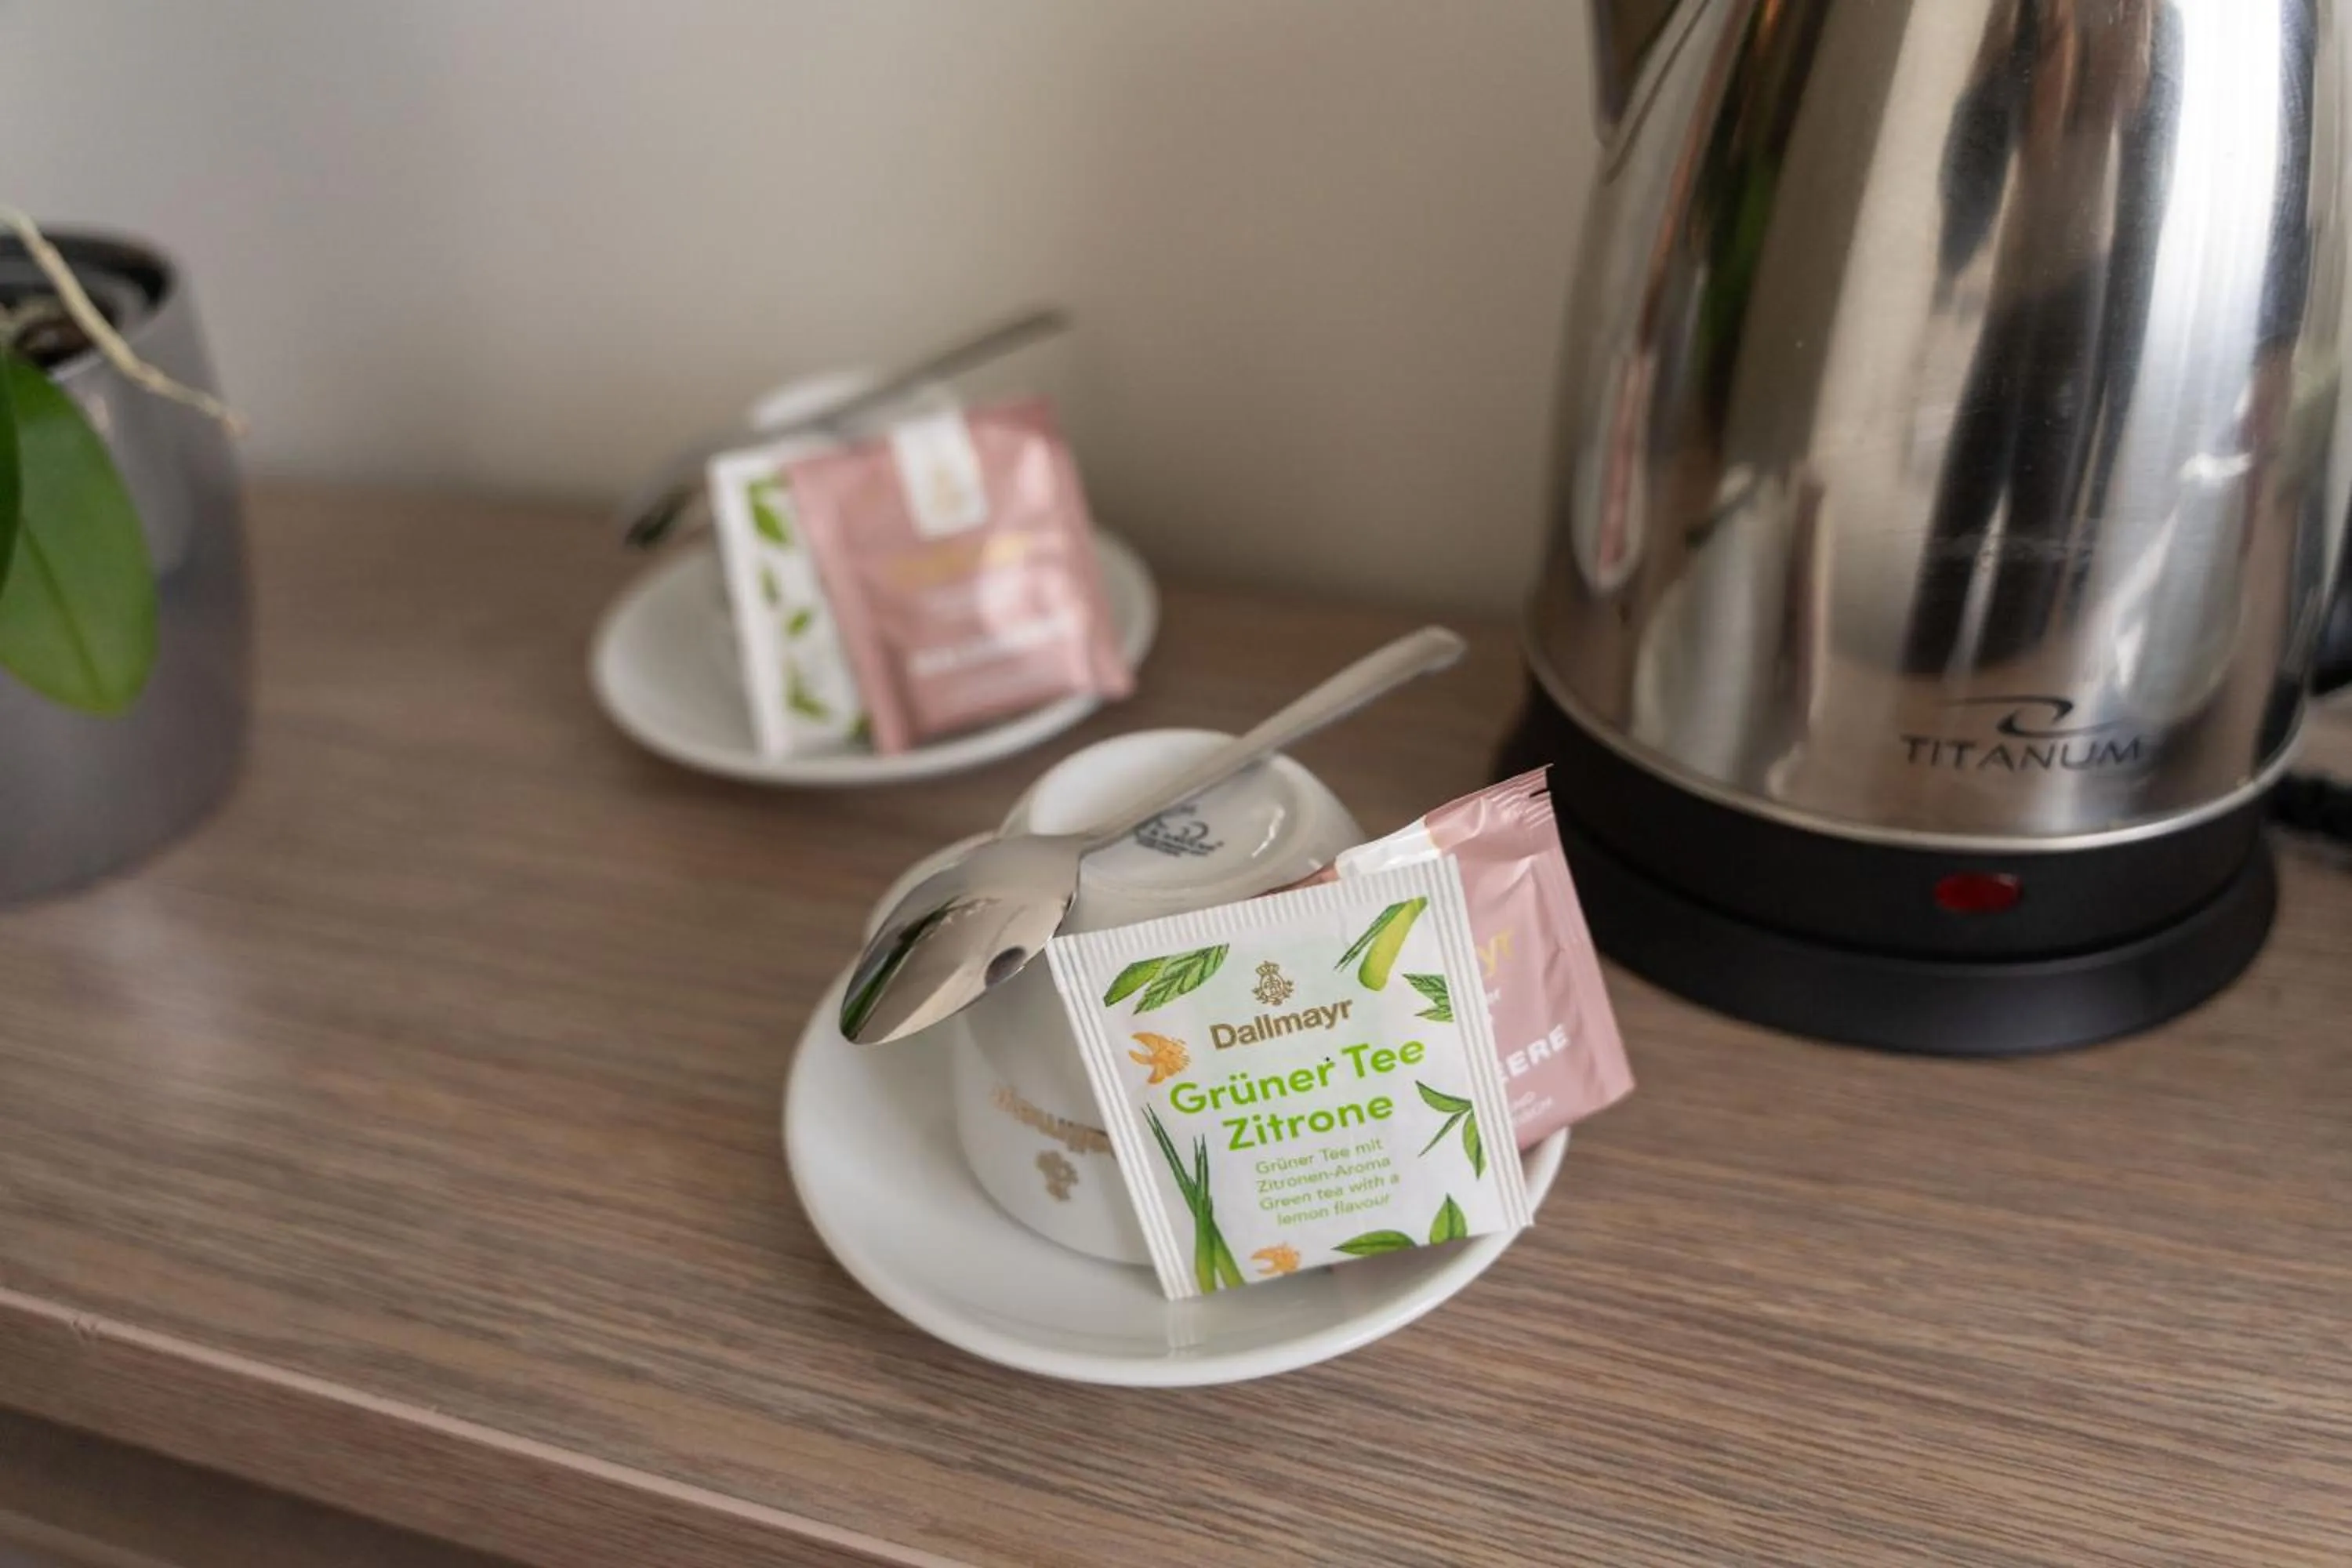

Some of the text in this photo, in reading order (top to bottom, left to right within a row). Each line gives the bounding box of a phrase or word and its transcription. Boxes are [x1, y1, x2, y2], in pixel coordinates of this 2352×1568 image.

[1900, 733, 2140, 771] TITANUM
[1209, 999, 1352, 1051] Dallmayr
[1169, 1040, 1425, 1114] Grüner Tee
[1221, 1095, 1394, 1151] Zitrone
[1255, 1138, 1384, 1174] Grüner Tee mit
[1256, 1156, 1392, 1194] Zitronen-Aroma
[1259, 1173, 1401, 1210] Green tea with a
[1276, 1192, 1391, 1226] lemon flavour
